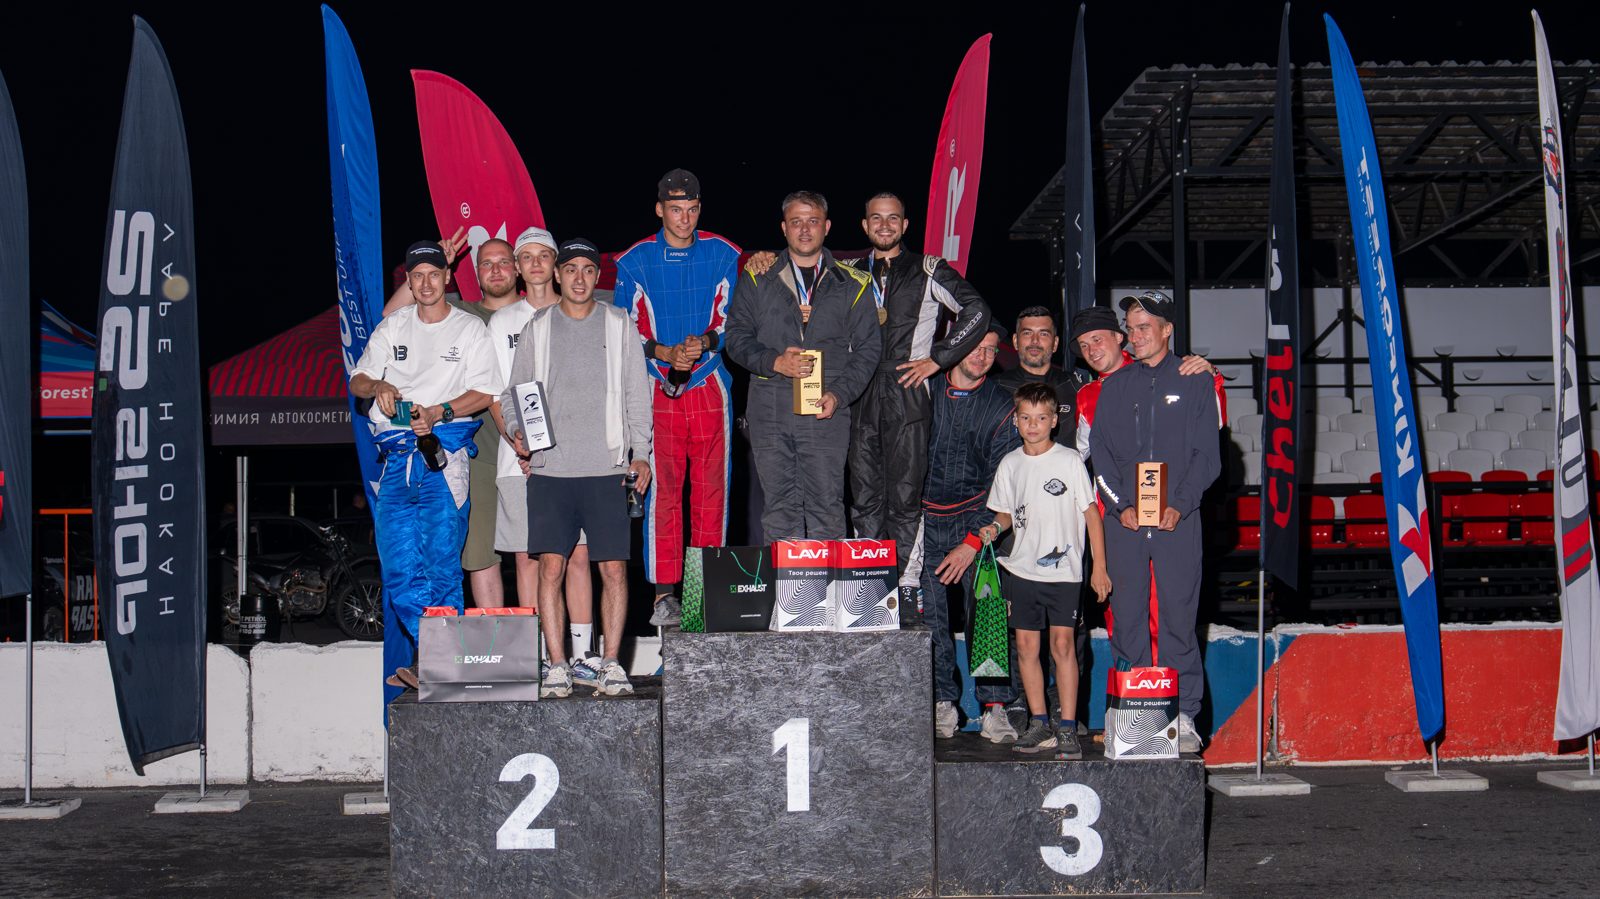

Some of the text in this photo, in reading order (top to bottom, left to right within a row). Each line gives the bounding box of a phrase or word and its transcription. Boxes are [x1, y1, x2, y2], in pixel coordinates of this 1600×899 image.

[393, 345, 408, 361] 13
[210, 411, 352, 425] ИМИЯ АВТОКОСМЕТИ
[851, 547, 890, 560] LAVR
[464, 655, 503, 664] EXHAUST
[1126, 679, 1171, 690] LAVR
[771, 717, 810, 812] 1
[496, 752, 560, 850] 2
[1040, 784, 1103, 876] 3
